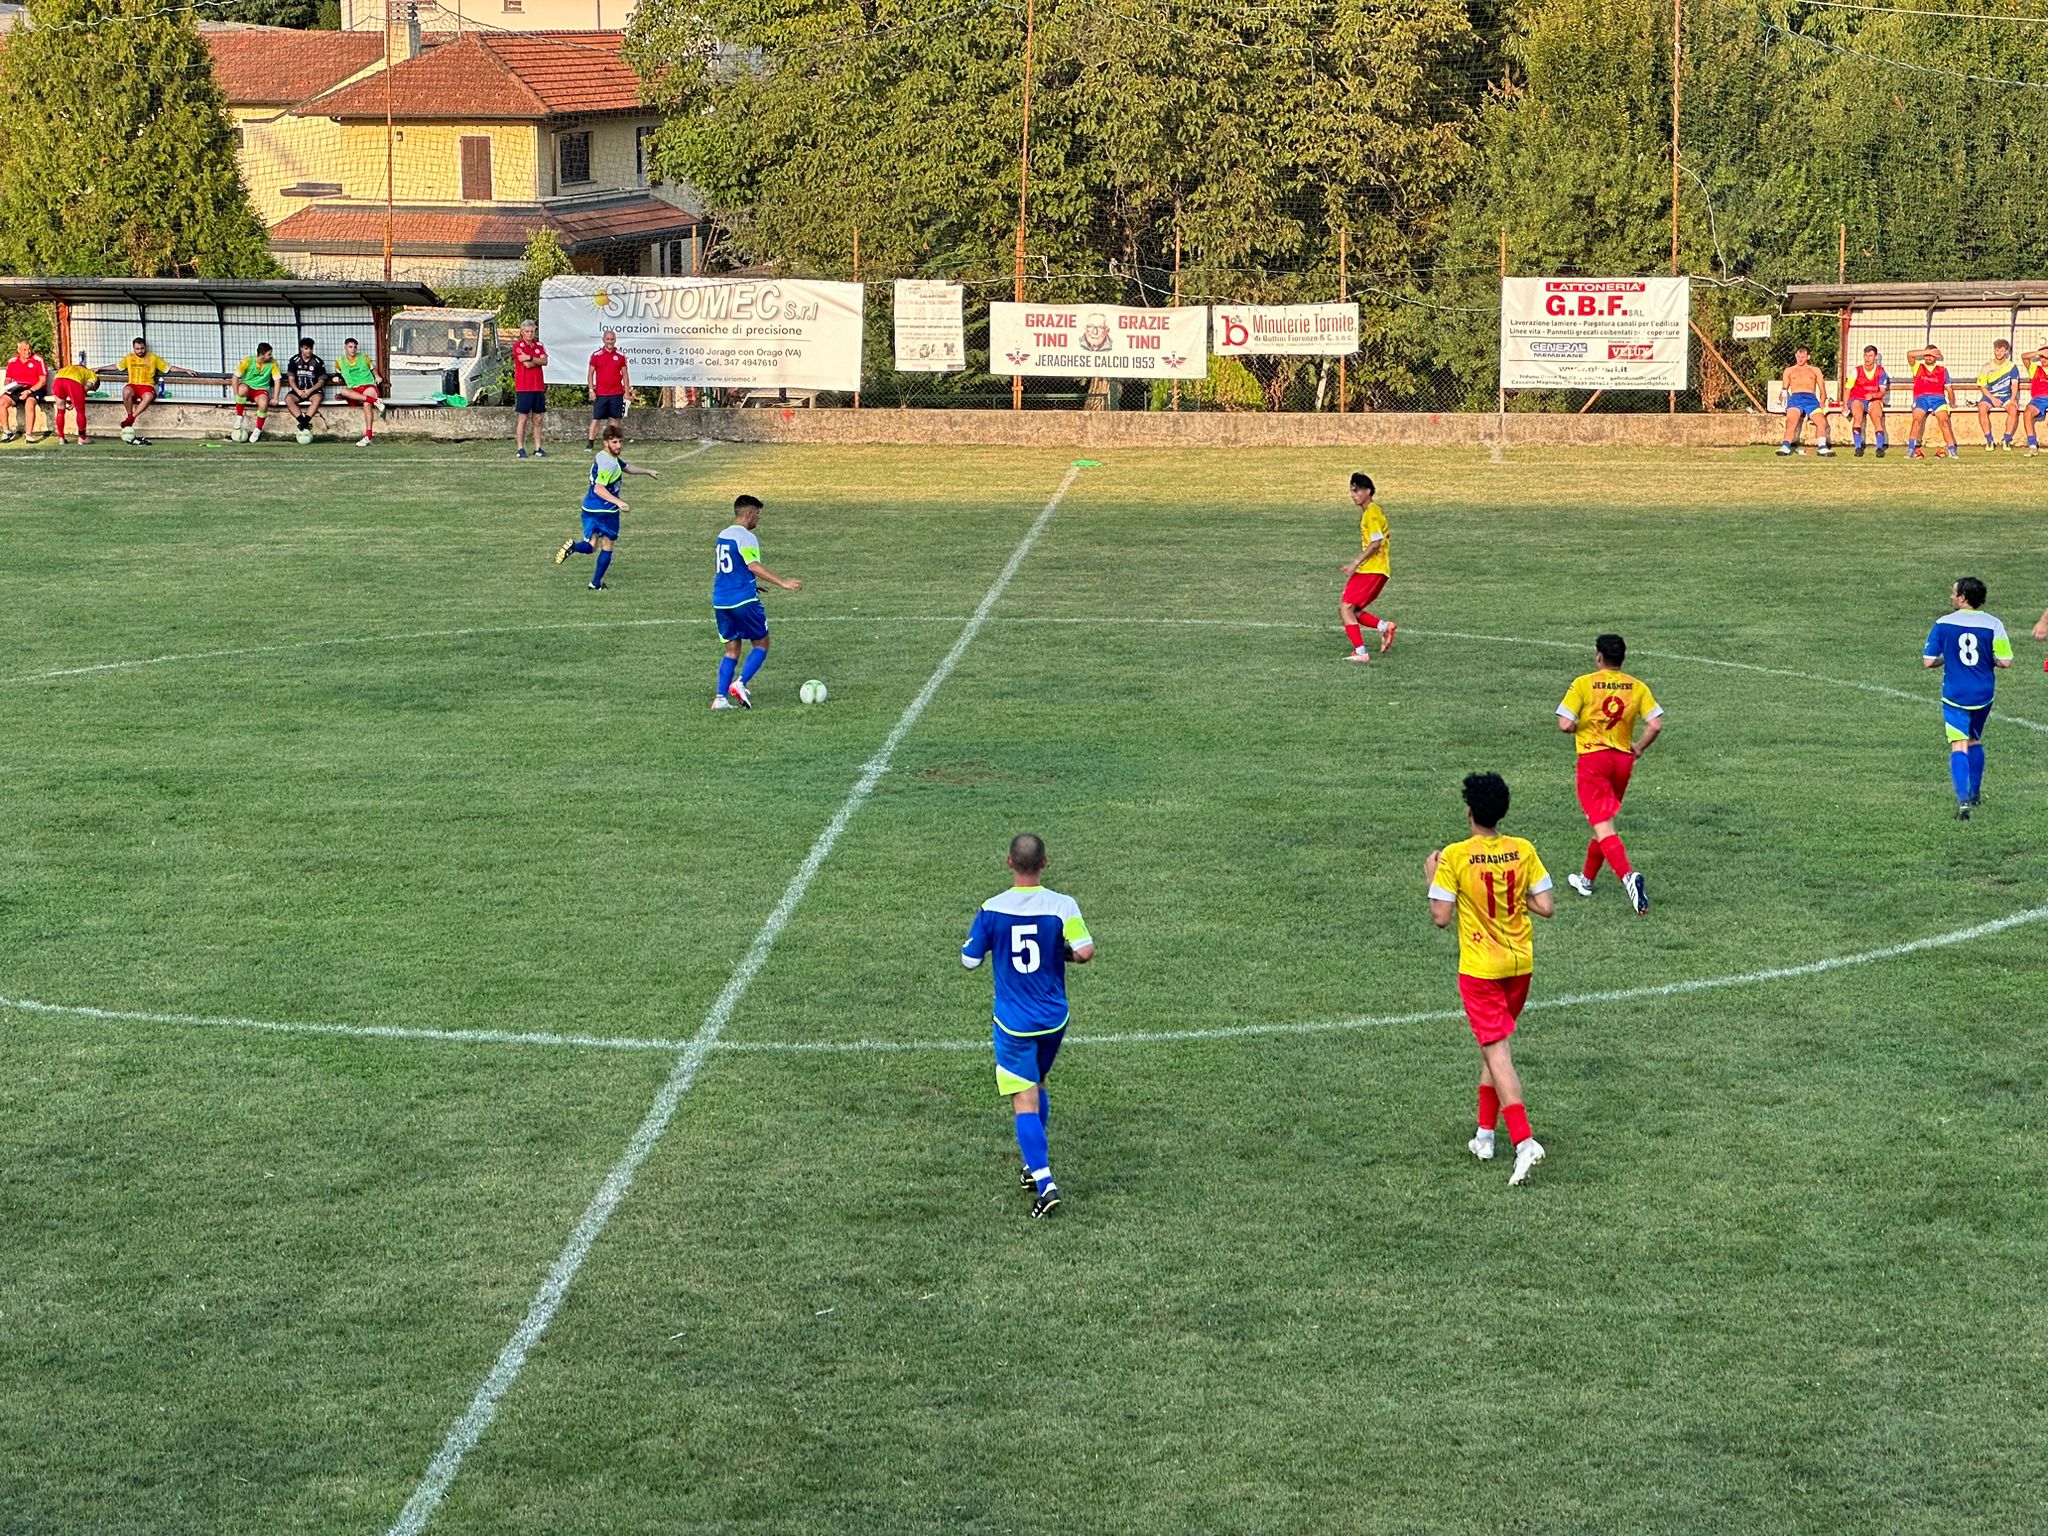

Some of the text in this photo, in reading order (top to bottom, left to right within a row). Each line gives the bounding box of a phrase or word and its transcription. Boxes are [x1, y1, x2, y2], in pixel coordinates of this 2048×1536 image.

[1549, 283, 1641, 291] LATTONERIA
[603, 281, 780, 321] SIRIOMEC
[1545, 295, 1628, 316] G.B.F.
[1025, 313, 1077, 328] GRAZIE
[1118, 315, 1170, 330] GRAZIE
[1253, 313, 1354, 333] Minuterie Tornite
[1510, 319, 1550, 327] Lavorazione
[1583, 320, 1615, 329] Piegatura
[599, 322, 802, 336] lavorazioni meccaniche di precisione
[1509, 327, 1527, 335] Linee
[1576, 329, 1599, 337] grecati
[1033, 333, 1068, 347] TINO
[1126, 335, 1161, 349] TINO
[665, 347, 671, 355] 6
[706, 348, 735, 357] Jerago
[756, 348, 782, 357] Orago
[785, 348, 802, 357] (VA)
[1532, 343, 1585, 352] GENERAL
[1612, 347, 1651, 357] VELUX
[664, 358, 695, 366] 217948
[742, 359, 778, 367] 4947610
[1035, 355, 1155, 369] JERAGHESE CALCIO 1953
[644, 374, 697, 382] info@siriomec.it
[716, 544, 733, 574] 15
[1958, 632, 1979, 666] 8
[1592, 682, 1633, 690] JERAGHESE
[1602, 696, 1625, 730] 9
[1469, 851, 1519, 864] JERAGHESE
[1480, 869, 1516, 919] 11
[1011, 924, 1041, 974] 5
